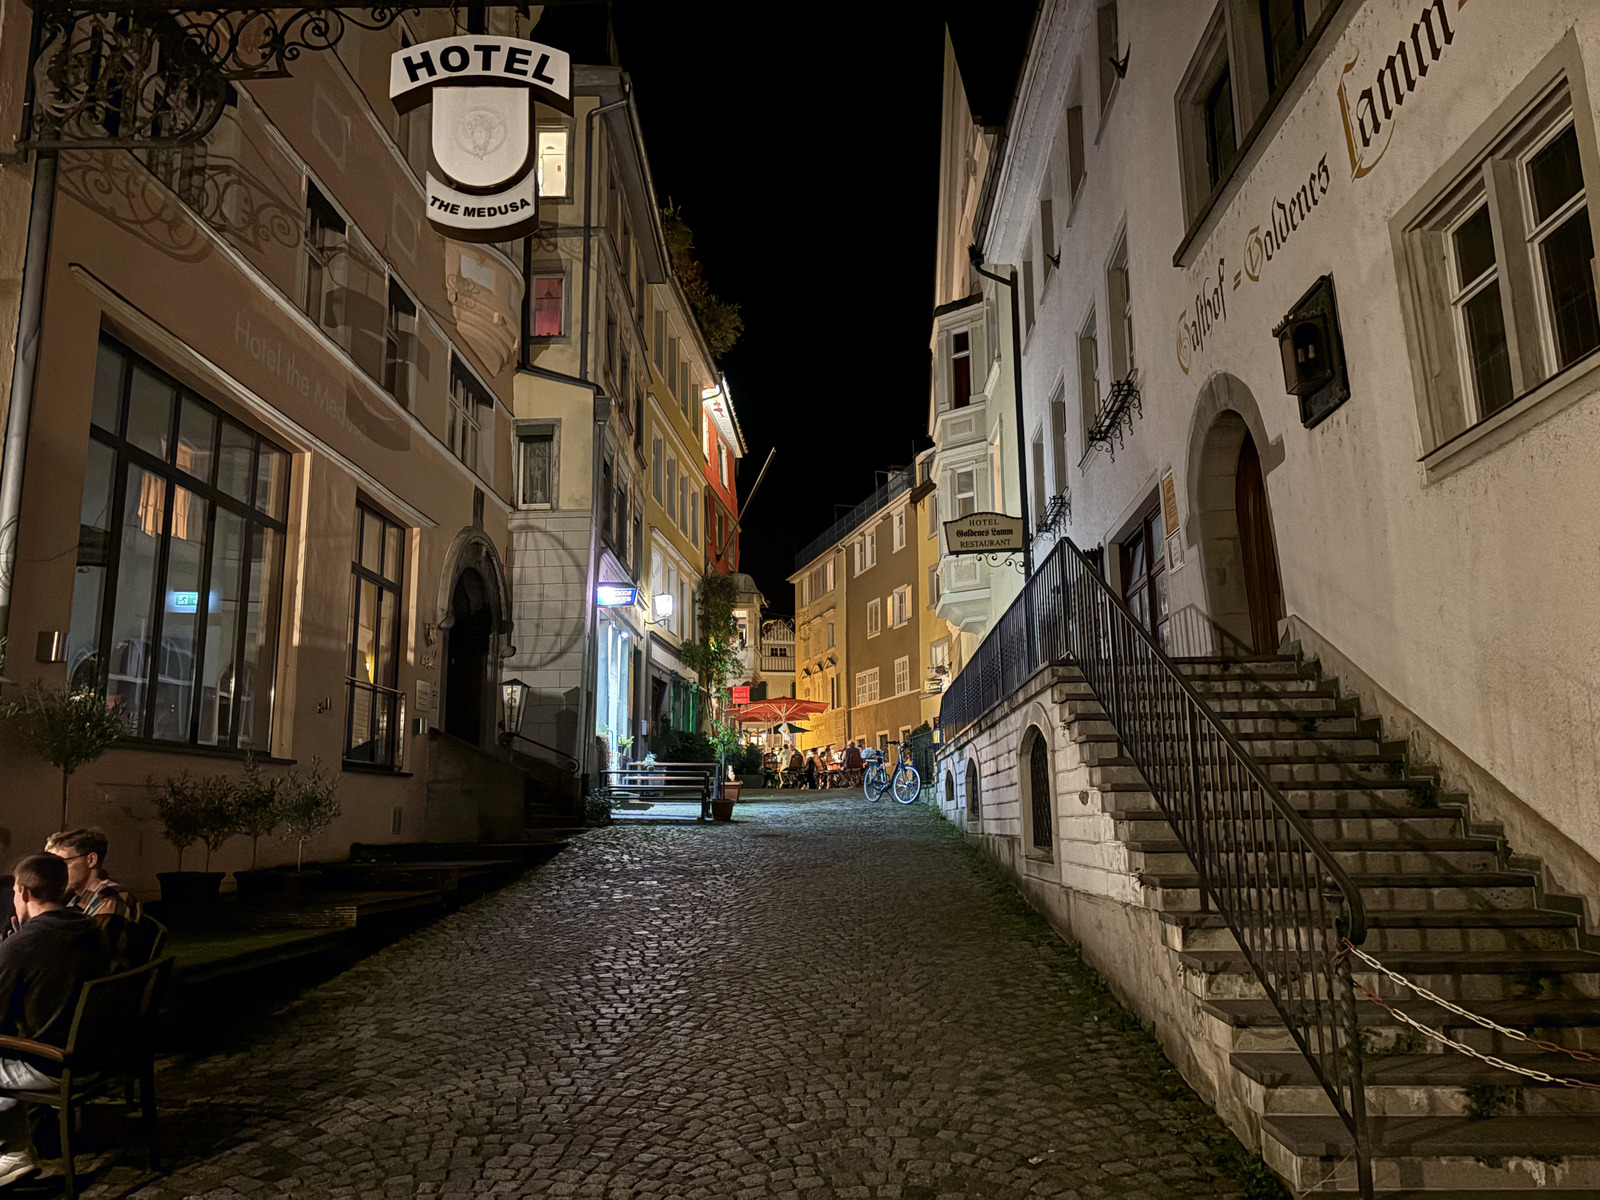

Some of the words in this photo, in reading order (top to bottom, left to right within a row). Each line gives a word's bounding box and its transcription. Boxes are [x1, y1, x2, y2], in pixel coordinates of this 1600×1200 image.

[402, 44, 555, 86] HOTEL
[1243, 151, 1330, 282] Goldenes
[1336, 0, 1456, 183] Lamm
[429, 195, 461, 215] THE
[462, 197, 532, 218] MEDUSA
[234, 310, 282, 376] Hotel
[286, 351, 311, 396] the
[955, 528, 990, 538] Goldenes
[990, 527, 1014, 537] Lamm
[968, 518, 1000, 527] HOTEL
[960, 538, 1012, 548] RESTAURANT
